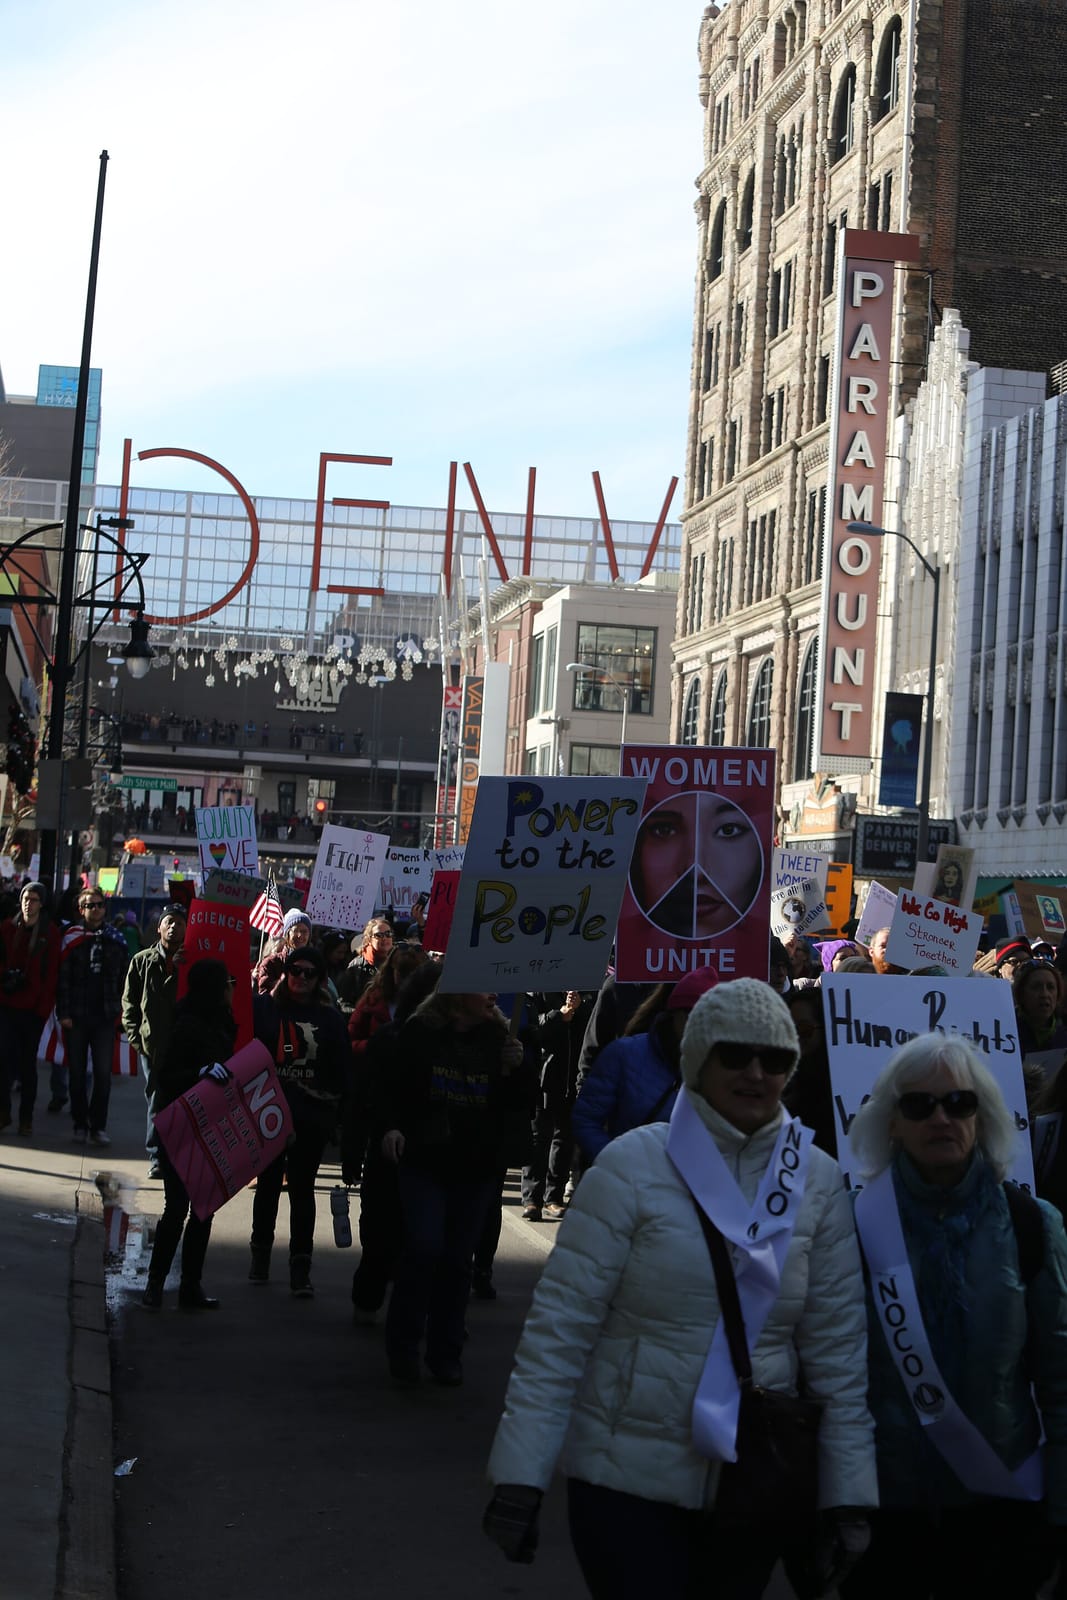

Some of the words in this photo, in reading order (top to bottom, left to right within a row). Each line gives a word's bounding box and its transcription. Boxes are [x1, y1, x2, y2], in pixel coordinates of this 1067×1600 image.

[830, 271, 884, 741] PARAMOUNT
[463, 680, 483, 756] VALET
[135, 778, 158, 788] Street
[160, 781, 176, 790] Mall
[630, 756, 768, 787] WOMEN
[196, 807, 253, 840] EQUALITY
[506, 781, 638, 837] Power
[865, 823, 945, 841] PARAMONT
[325, 843, 375, 874] FIGHT
[495, 838, 540, 869] to
[556, 838, 615, 869] the
[780, 854, 822, 872] TWEET
[316, 870, 343, 892] like
[355, 884, 364, 896] a
[403, 866, 420, 875] are
[190, 911, 245, 932] SCIENCE
[470, 881, 607, 947] People
[901, 893, 921, 916] We
[924, 901, 940, 922] Go
[943, 907, 968, 934] High
[198, 937, 210, 950] IS
[218, 939, 225, 952] A
[645, 948, 736, 974] UNITE
[828, 987, 918, 1049] Human
[242, 1068, 284, 1140] NO
[217, 1116, 240, 1150] FOR
[766, 1123, 801, 1216] NOCO
[878, 1277, 923, 1377] NOCO
